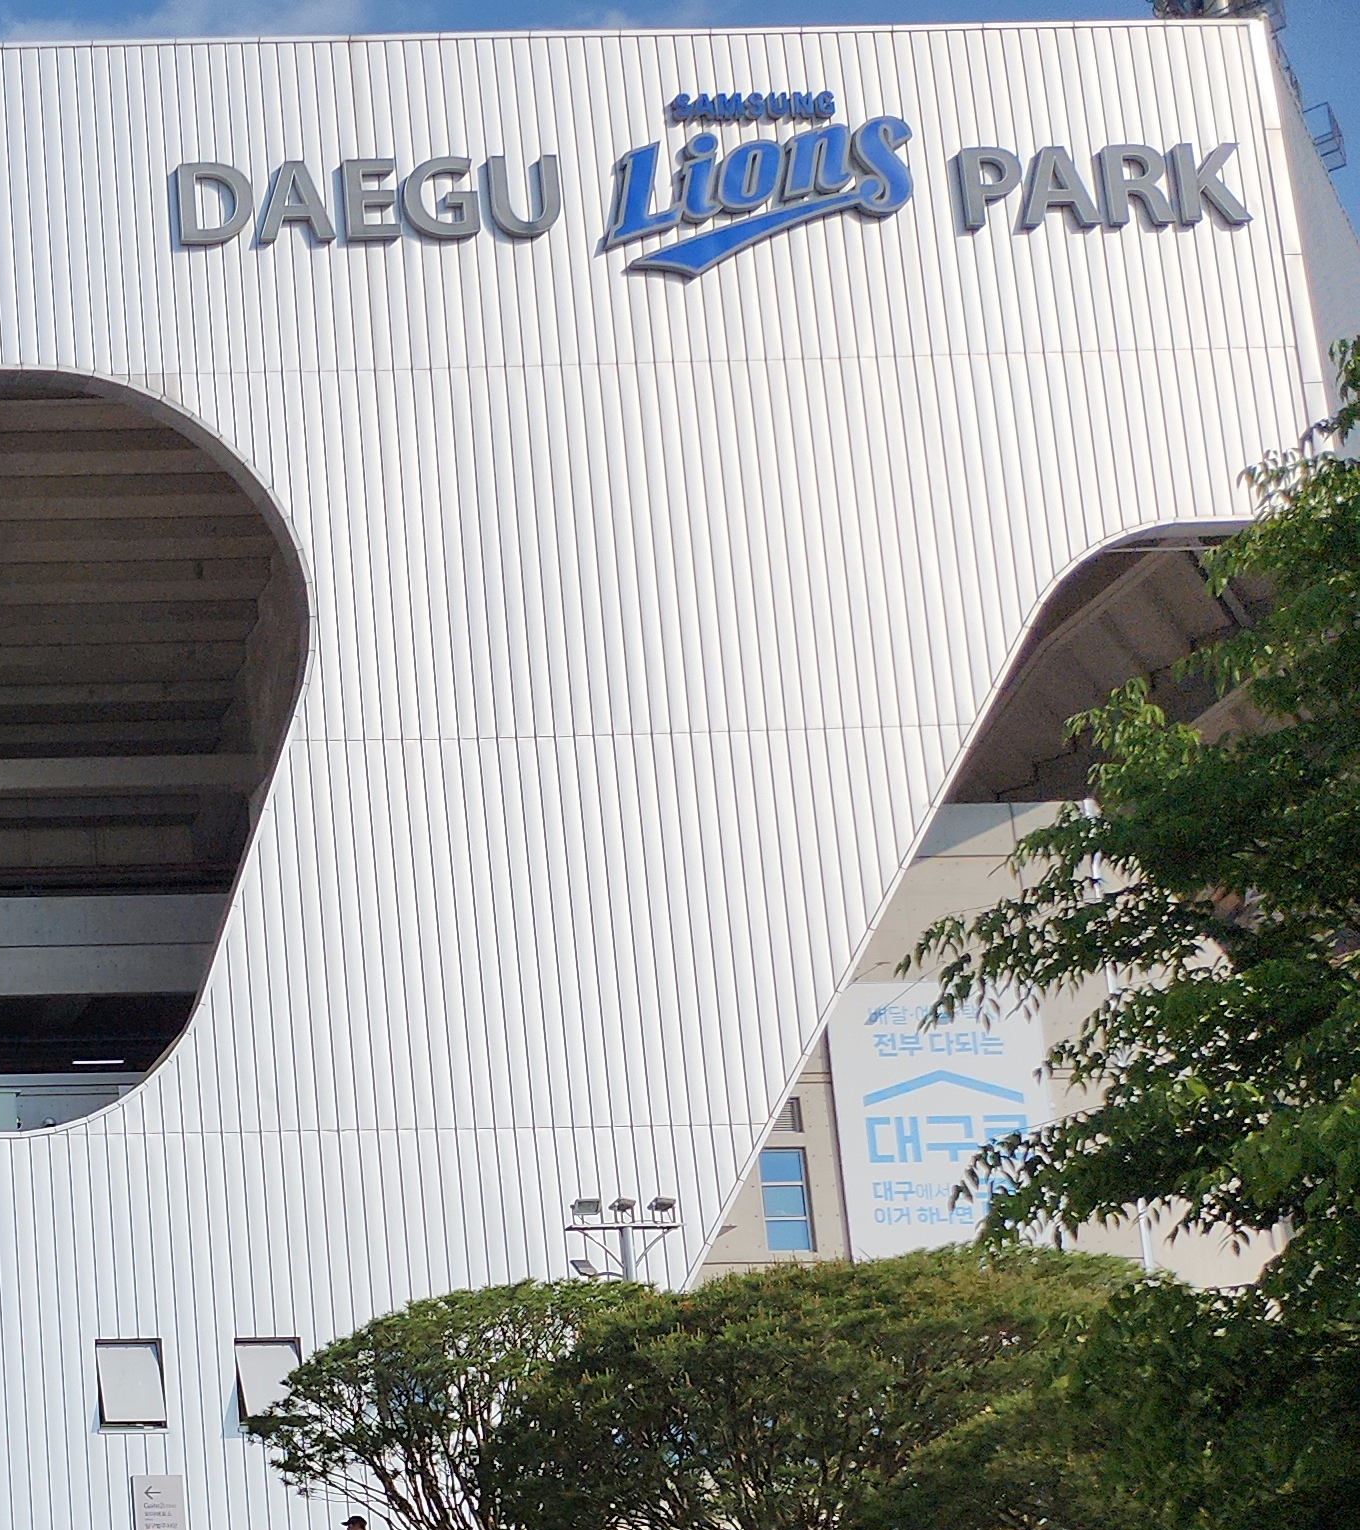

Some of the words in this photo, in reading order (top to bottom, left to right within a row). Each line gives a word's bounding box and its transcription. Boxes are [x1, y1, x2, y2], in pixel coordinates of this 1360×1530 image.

[667, 91, 836, 122] SAMSUNG
[176, 155, 561, 245] DAEGU
[604, 116, 914, 251] Lions
[957, 143, 1253, 230] PARK
[873, 1032, 923, 1058] 전부
[929, 1031, 1004, 1056] 다되는
[874, 1206, 912, 1226] 이거
[916, 1205, 974, 1225] 하나면
